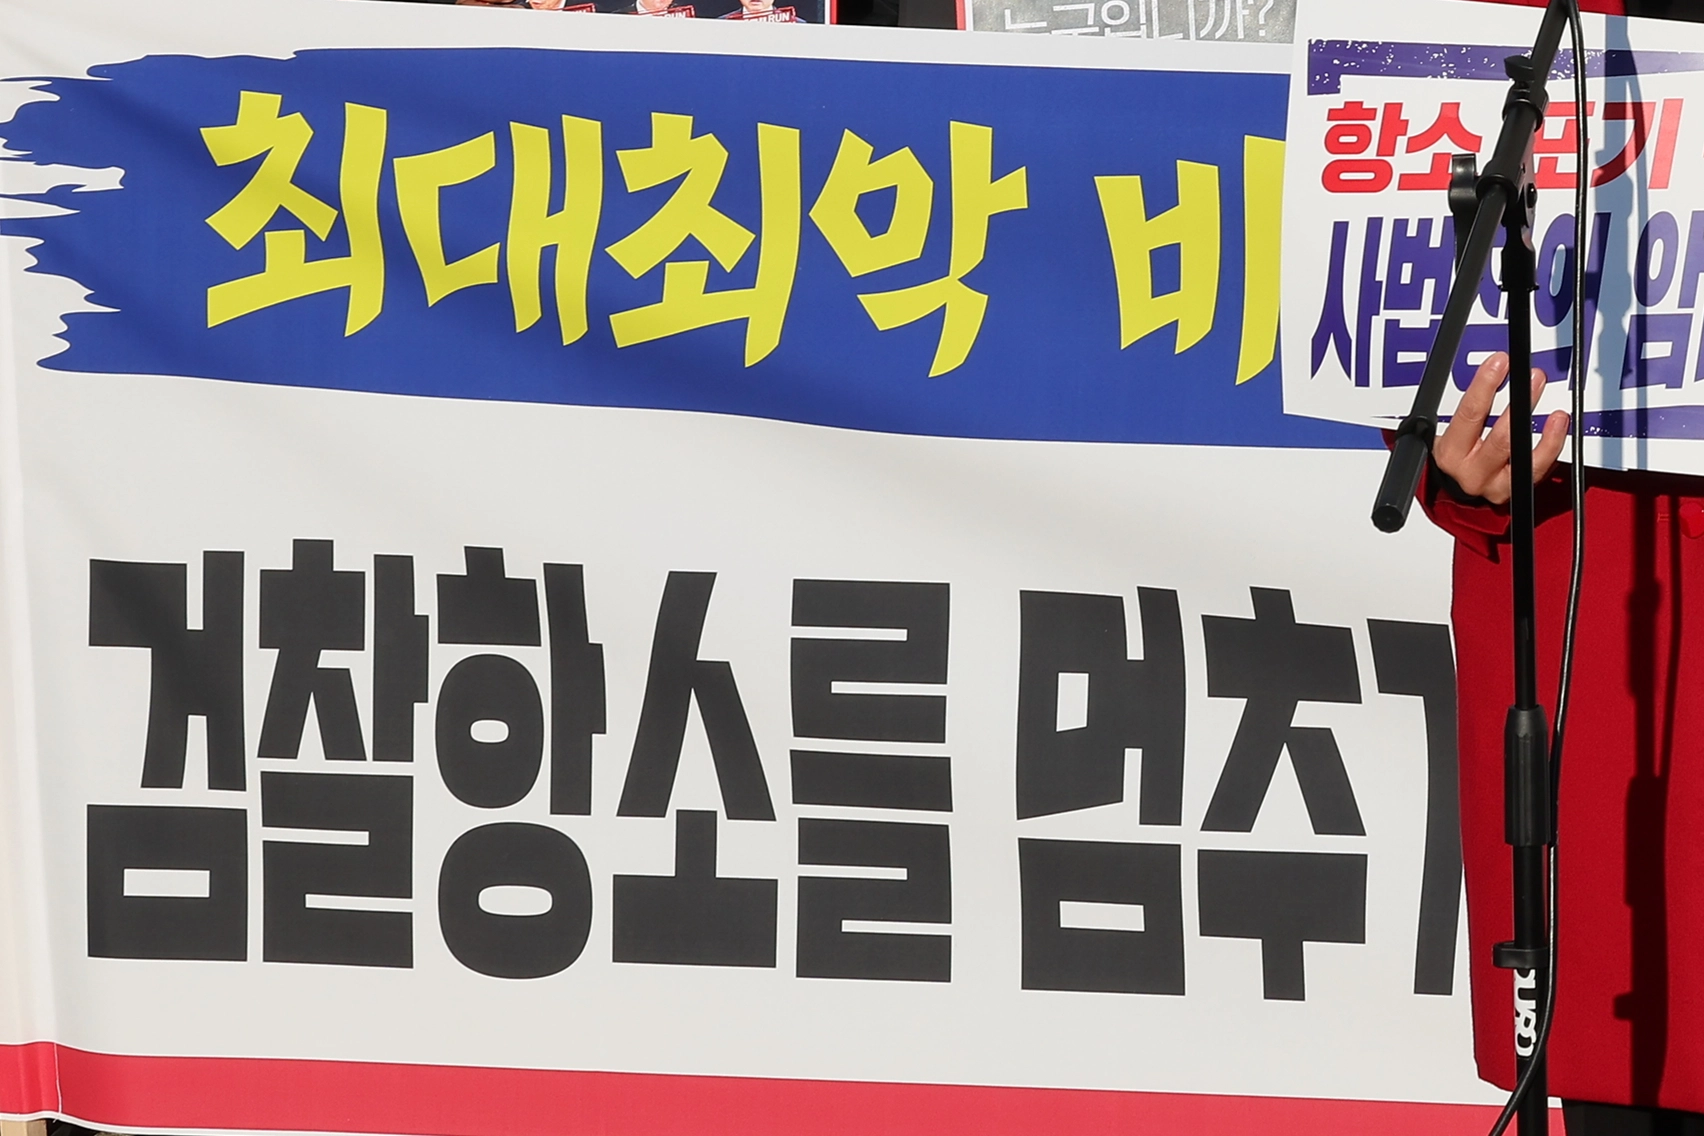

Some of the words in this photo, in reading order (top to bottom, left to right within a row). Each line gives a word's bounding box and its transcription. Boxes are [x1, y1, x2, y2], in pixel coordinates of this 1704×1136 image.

[200, 90, 1029, 378] 최대최악
[1321, 100, 1482, 194] 항소
[86, 538, 954, 983] 검찰항소를
